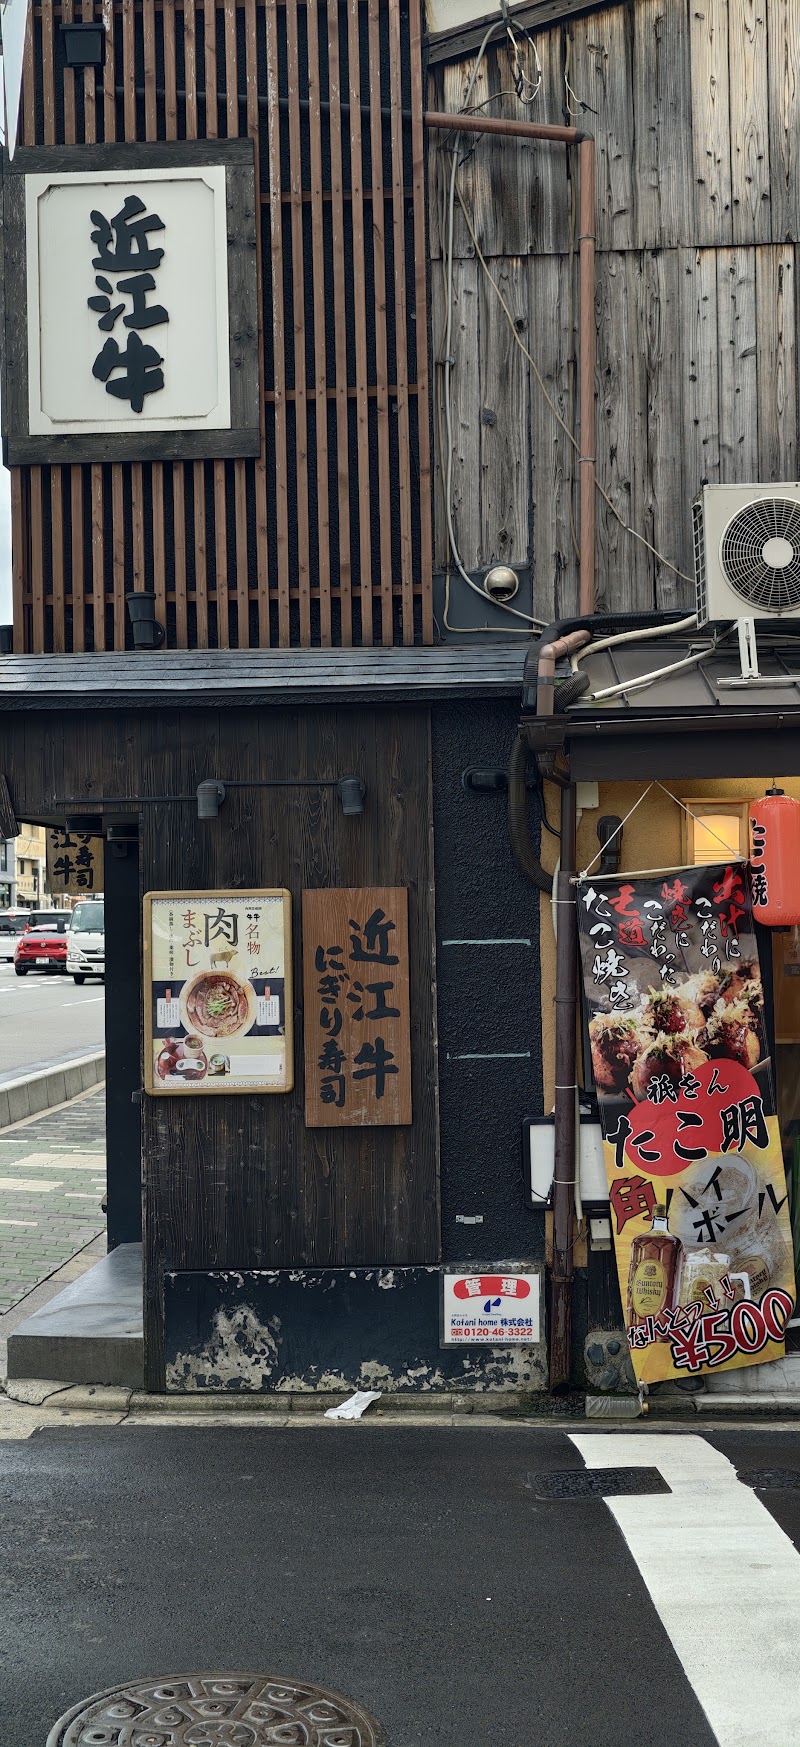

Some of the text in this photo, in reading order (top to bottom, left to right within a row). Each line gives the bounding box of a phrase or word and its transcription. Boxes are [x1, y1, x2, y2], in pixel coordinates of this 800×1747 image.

[87, 195, 169, 413] 近江牛
[181, 909, 202, 967] まぶし
[203, 907, 239, 947] 肉
[245, 923, 261, 955] 名物
[582, 887, 634, 1010] たこ焼き
[643, 900, 676, 984] こだわった
[660, 879, 693, 950] 焼きに
[695, 897, 721, 976] こだわり
[712, 866, 746, 961] 出汁に
[250, 966, 279, 978] Best!
[347, 908, 400, 1099] 近江牛
[315, 945, 349, 1107] にぎり寿司
[606, 1095, 770, 1168] たこ明
[609, 1175, 657, 1235] 角
[465, 1279, 517, 1296] 管理
[635, 1279, 663, 1289] Suntory
[451, 1318, 533, 1327] Kotani home 株式会社
[464, 1328, 533, 1336] 0120-46-3322
[669, 1289, 793, 1371] ¥500
